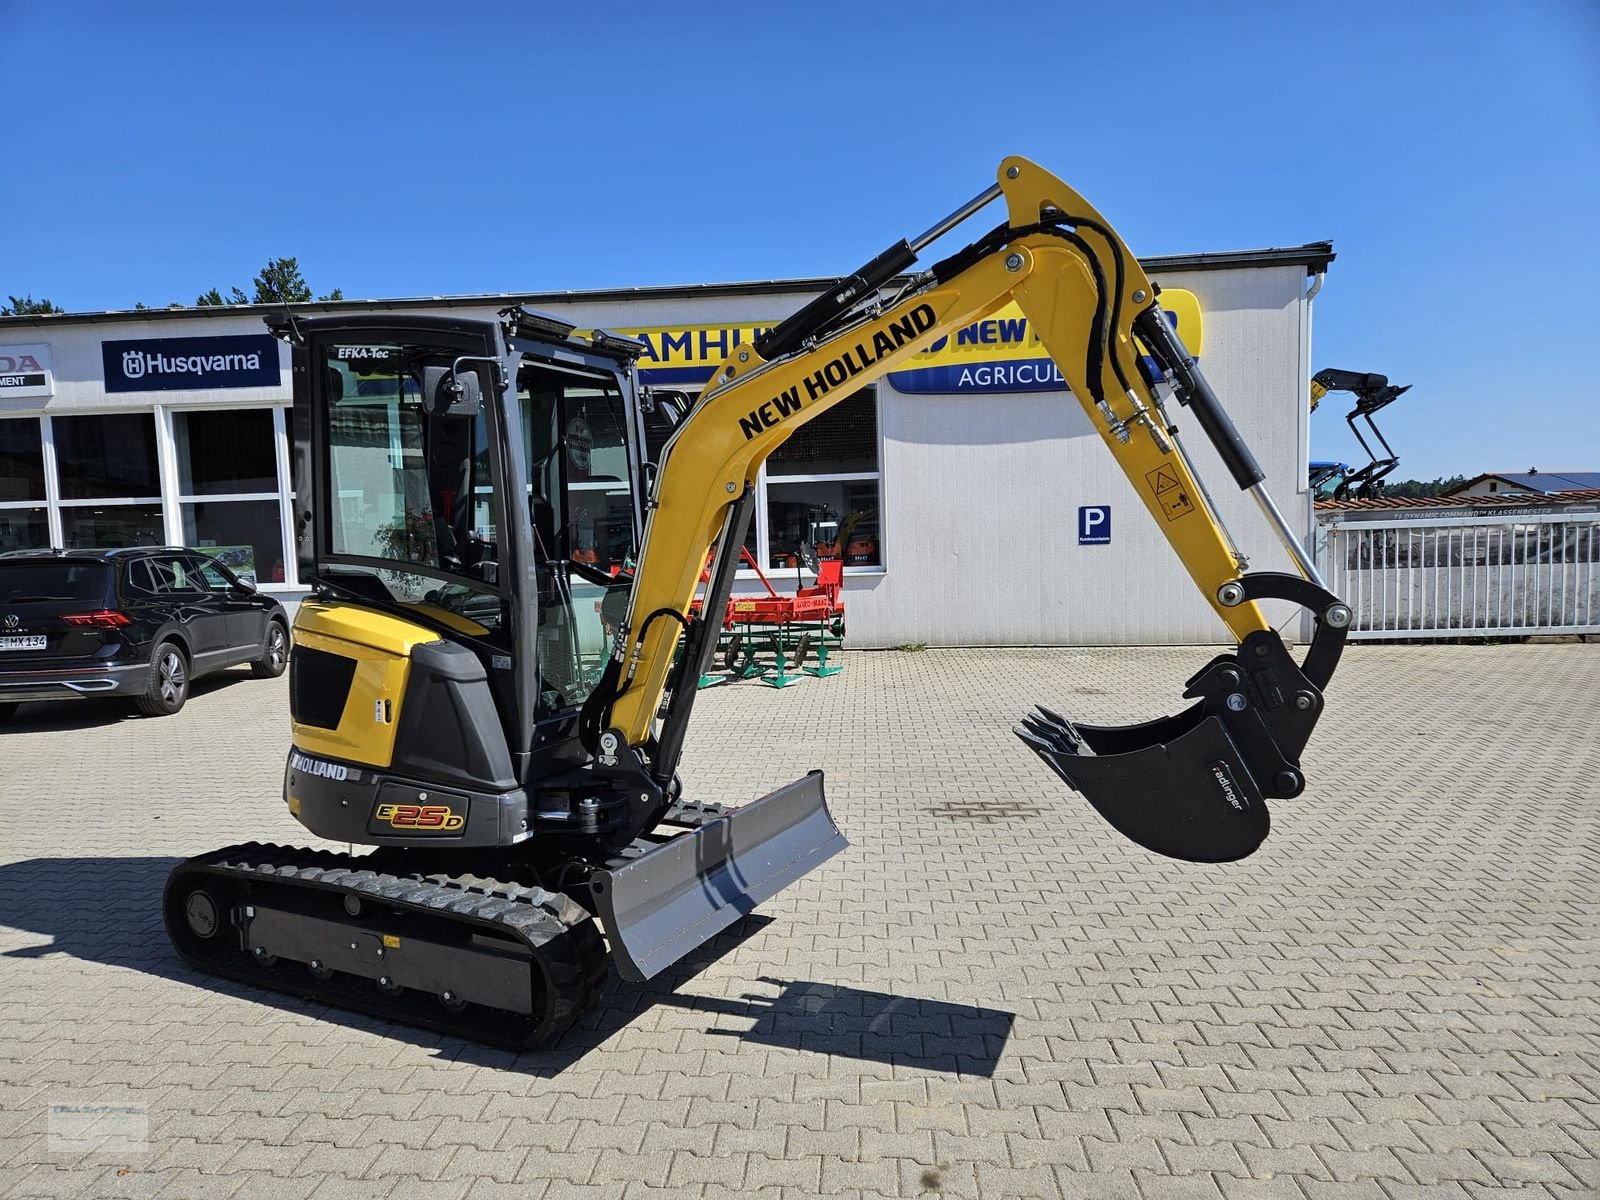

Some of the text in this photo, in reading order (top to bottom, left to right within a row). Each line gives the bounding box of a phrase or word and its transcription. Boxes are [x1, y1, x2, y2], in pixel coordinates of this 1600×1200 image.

[637, 328, 770, 362] AMH
[957, 318, 1028, 346] NEW
[146, 353, 260, 376] Husqvarna
[338, 348, 389, 360] EFKA-Tec
[738, 303, 936, 440] NEW HOLLAND
[1085, 508, 1105, 535] P
